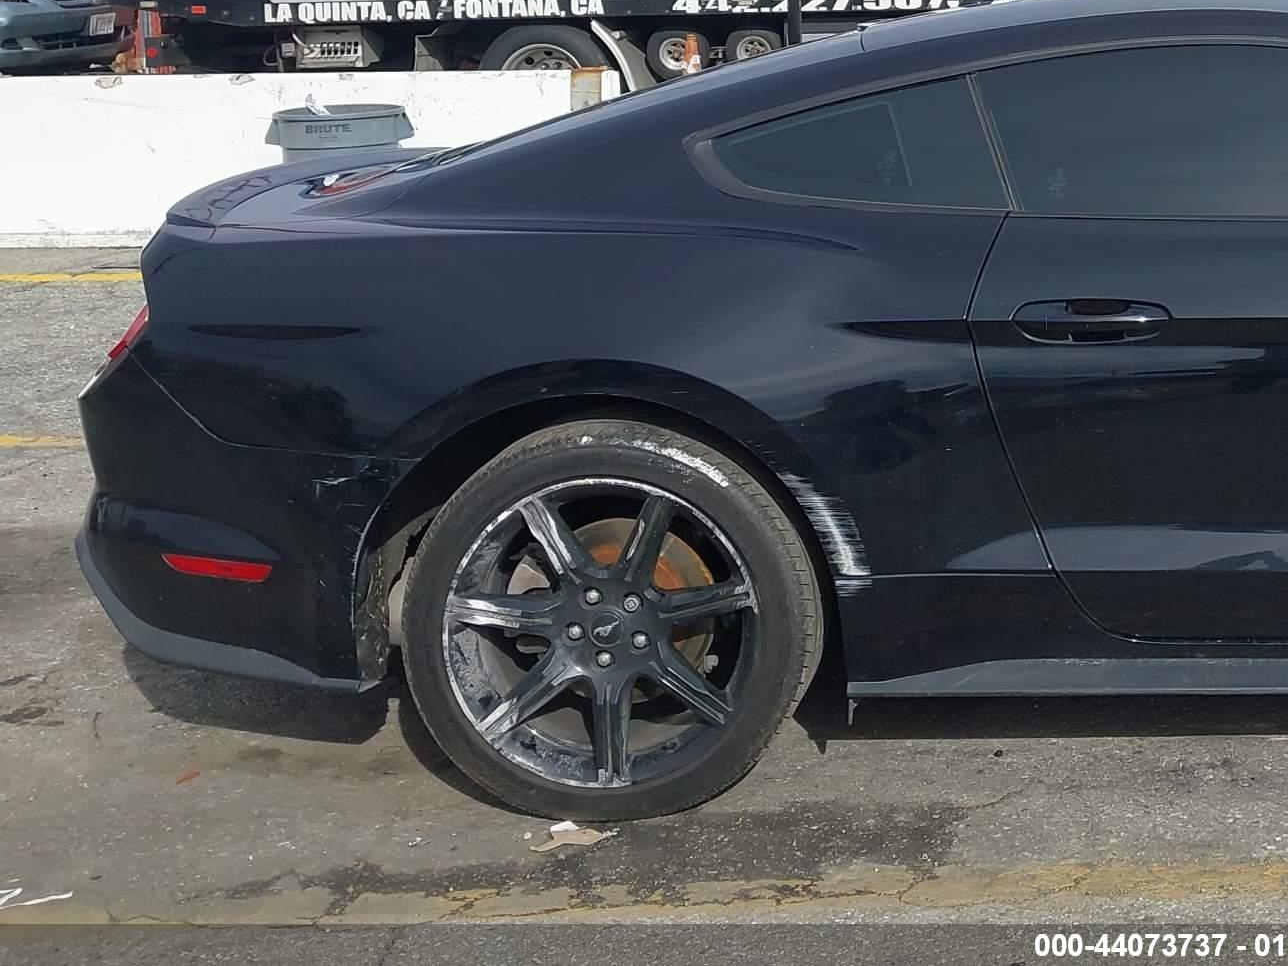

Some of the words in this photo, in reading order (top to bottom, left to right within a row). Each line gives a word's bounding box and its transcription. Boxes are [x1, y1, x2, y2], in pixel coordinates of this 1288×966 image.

[264, 3, 293, 23] LA
[297, 1, 393, 24] QUINTA,
[397, 0, 431, 21] CA
[305, 123, 352, 134] BRUTE
